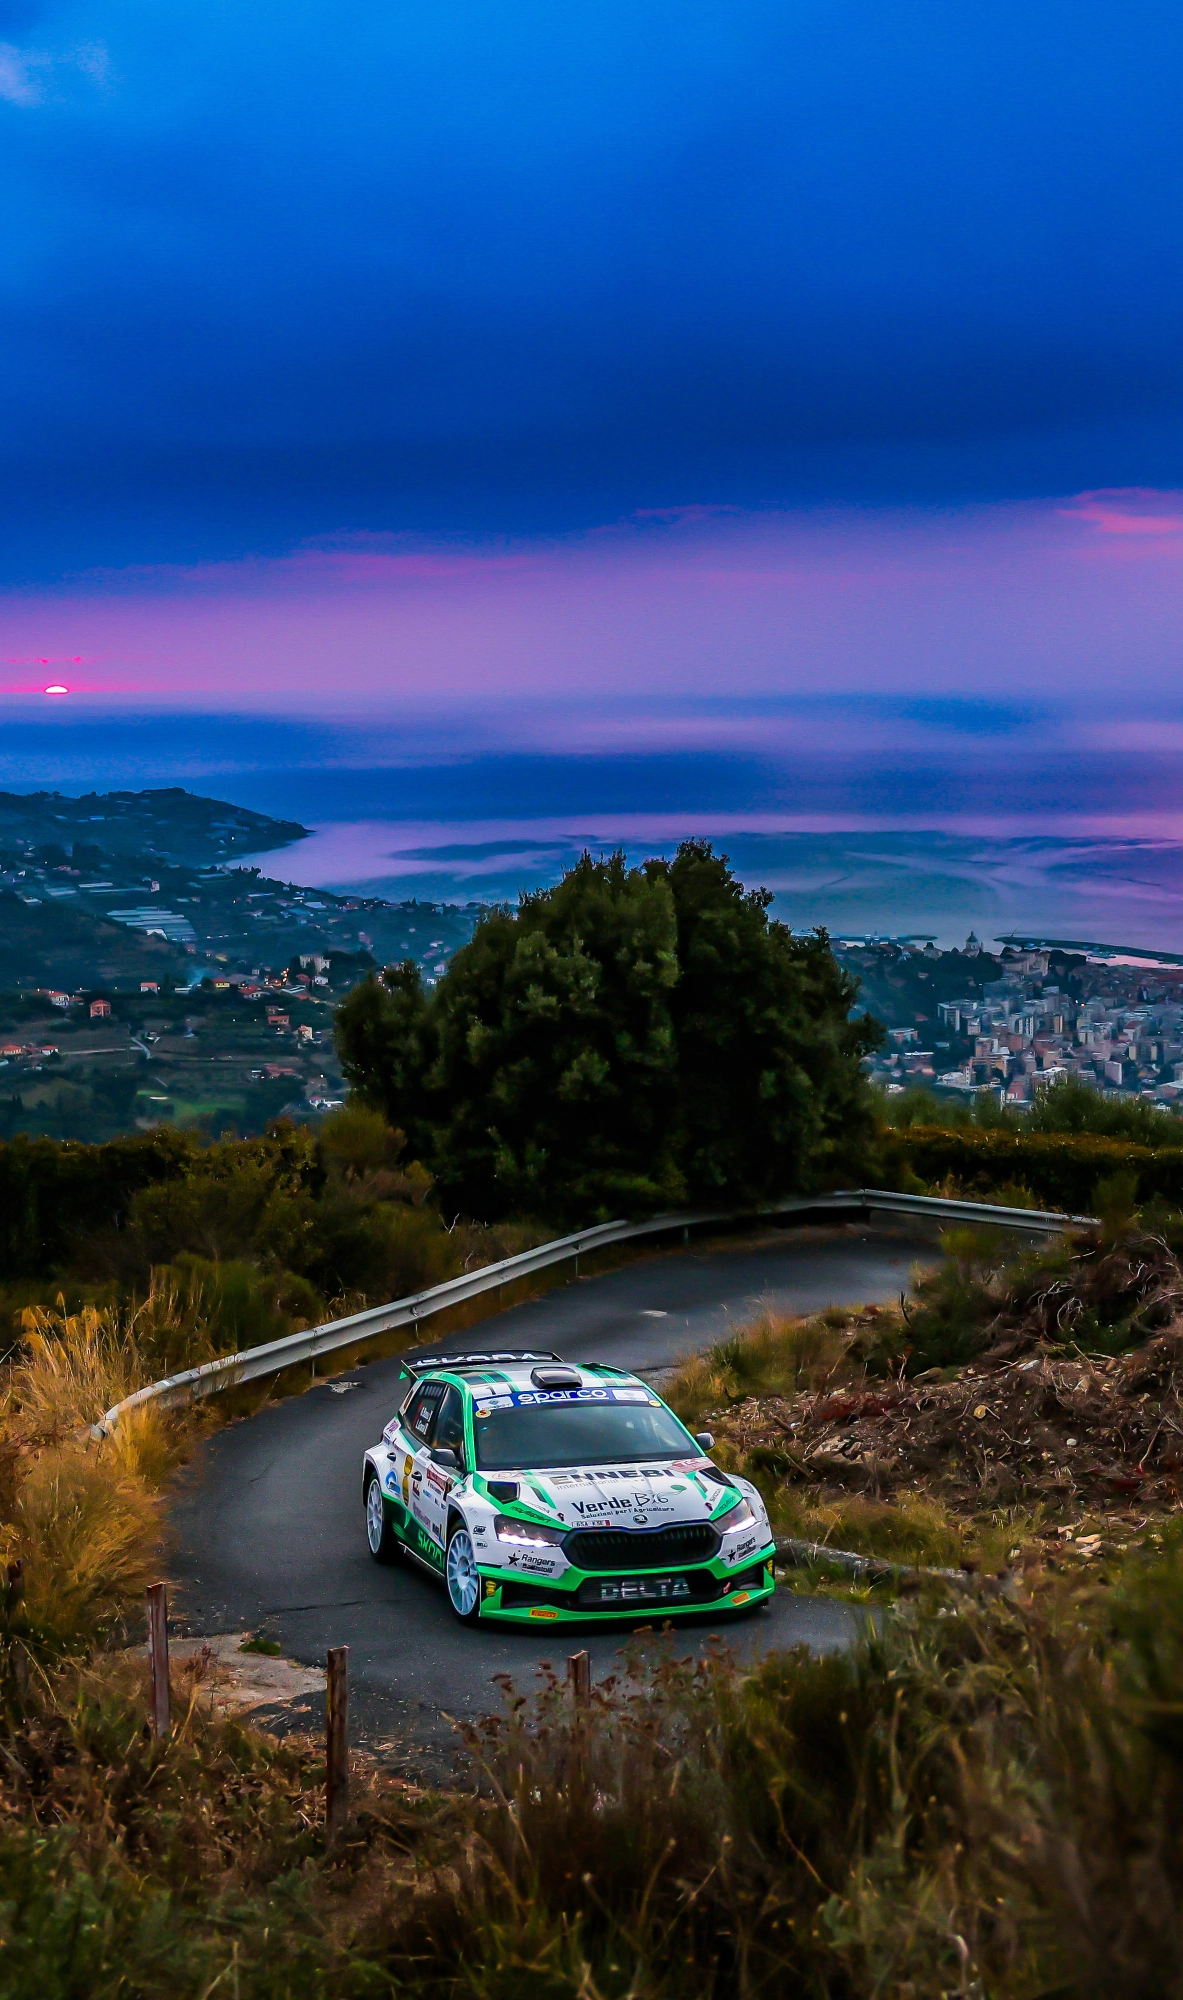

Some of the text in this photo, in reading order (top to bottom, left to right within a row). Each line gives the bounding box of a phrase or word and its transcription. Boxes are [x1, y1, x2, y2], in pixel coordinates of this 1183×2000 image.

[517, 1388, 608, 1403] sparco
[549, 1468, 675, 1485] ENNEBI
[571, 1496, 632, 1513] Verde
[521, 1553, 556, 1567] Rangers
[601, 1579, 691, 1600] DELTA
